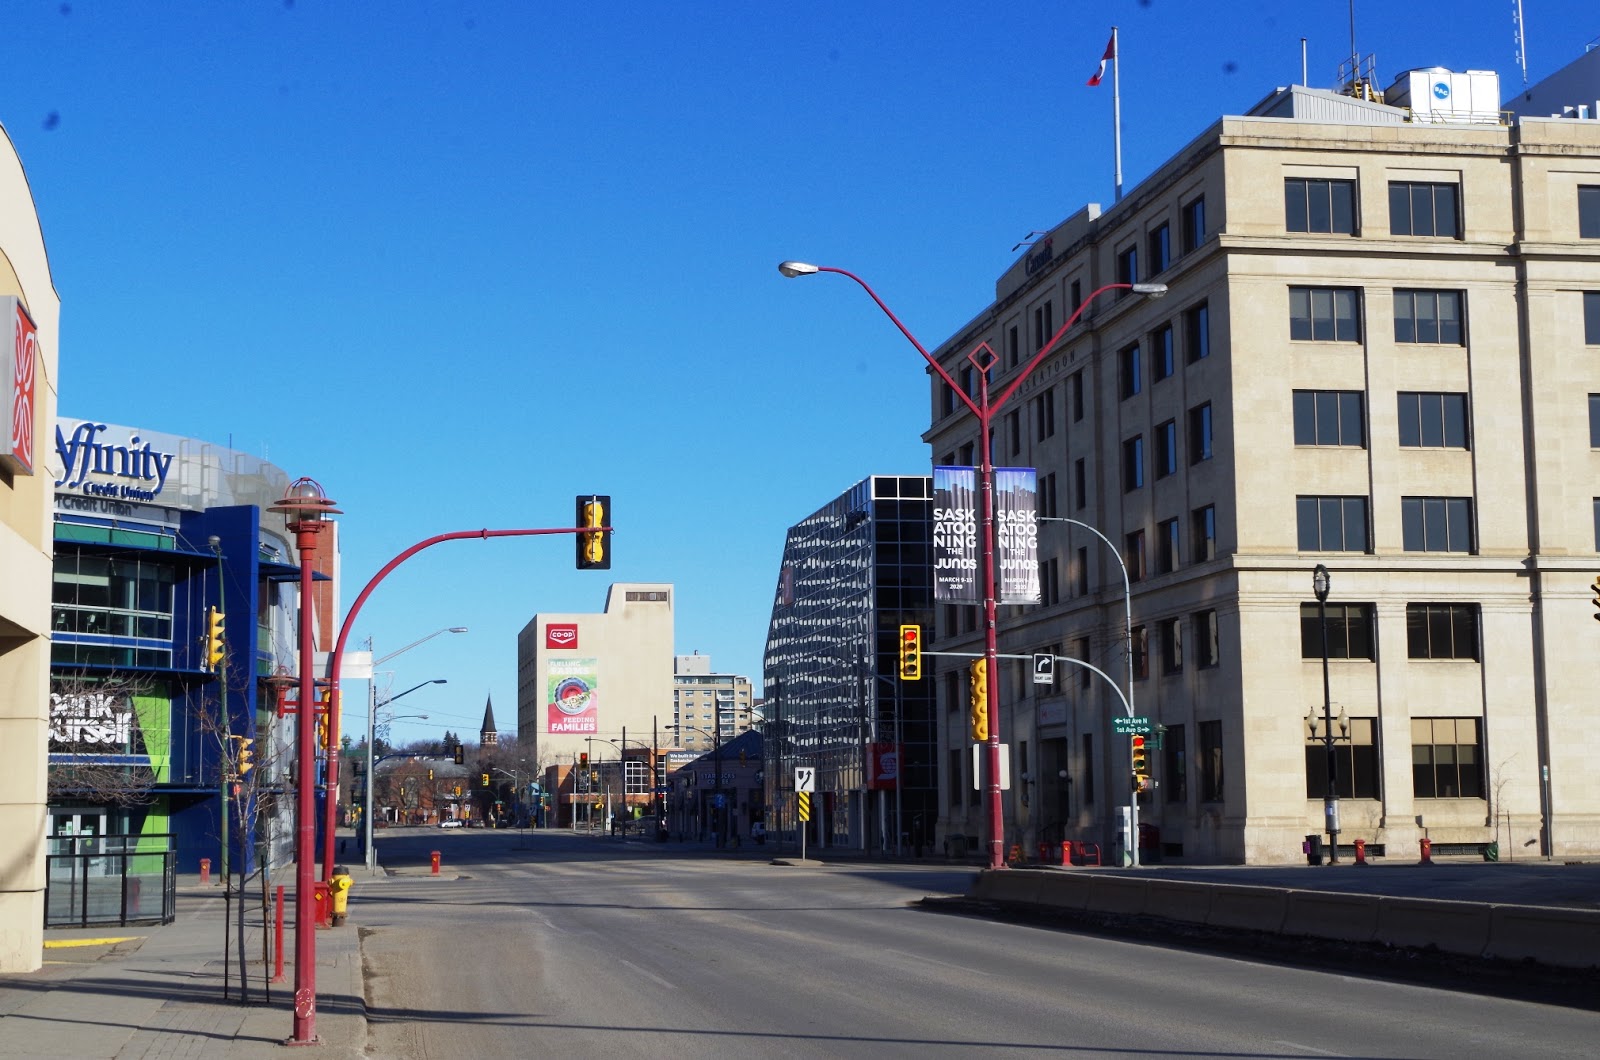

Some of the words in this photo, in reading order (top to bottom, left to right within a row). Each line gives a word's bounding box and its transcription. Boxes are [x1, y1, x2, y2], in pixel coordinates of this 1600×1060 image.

[1025, 243, 1053, 277] Canada
[1011, 348, 1076, 401] SASKATOON
[83, 481, 119, 498] Credit
[121, 484, 155, 502] Union
[933, 508, 976, 522] SASK
[997, 509, 1037, 523] SASK
[933, 522, 976, 535] ATOO
[998, 523, 1038, 536] ATOO
[933, 535, 976, 548] NING
[998, 536, 1038, 548] NING
[551, 723, 595, 731] FAMILIES
